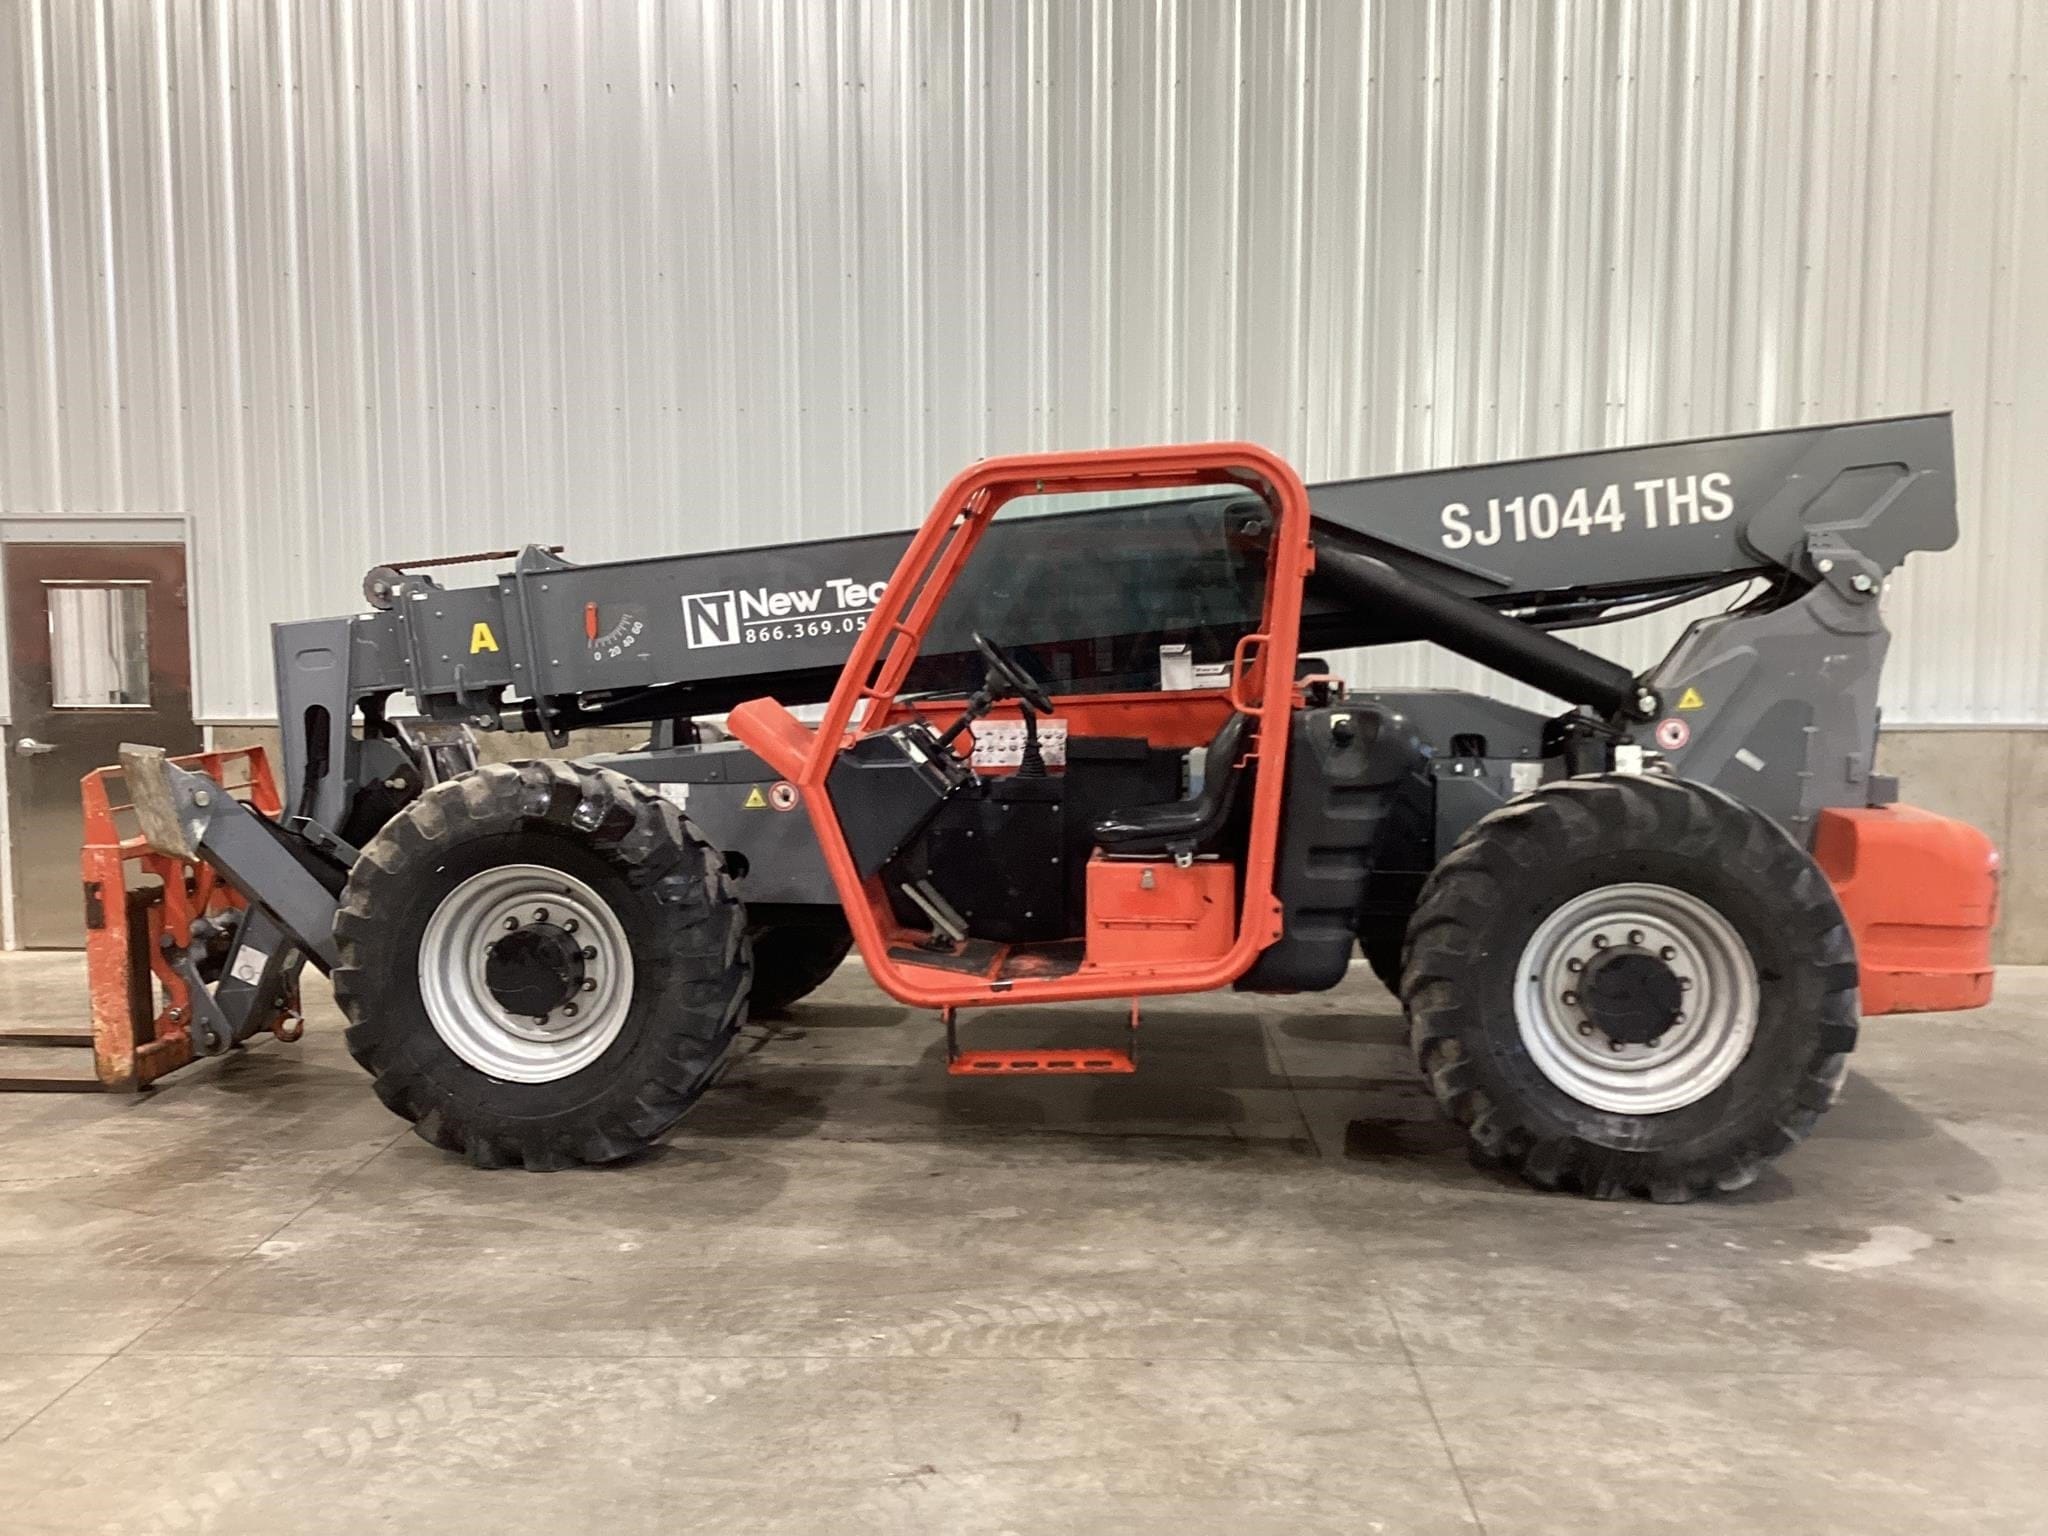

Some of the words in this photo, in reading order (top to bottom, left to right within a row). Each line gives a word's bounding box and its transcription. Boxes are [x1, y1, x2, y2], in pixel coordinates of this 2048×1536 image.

[1440, 484, 1626, 549] SJ1044
[1634, 472, 1734, 528] THS
[739, 587, 822, 619] New
[470, 622, 499, 654] A
[593, 651, 602, 661] 0
[608, 645, 621, 658] 20
[622, 635, 635, 647] 40
